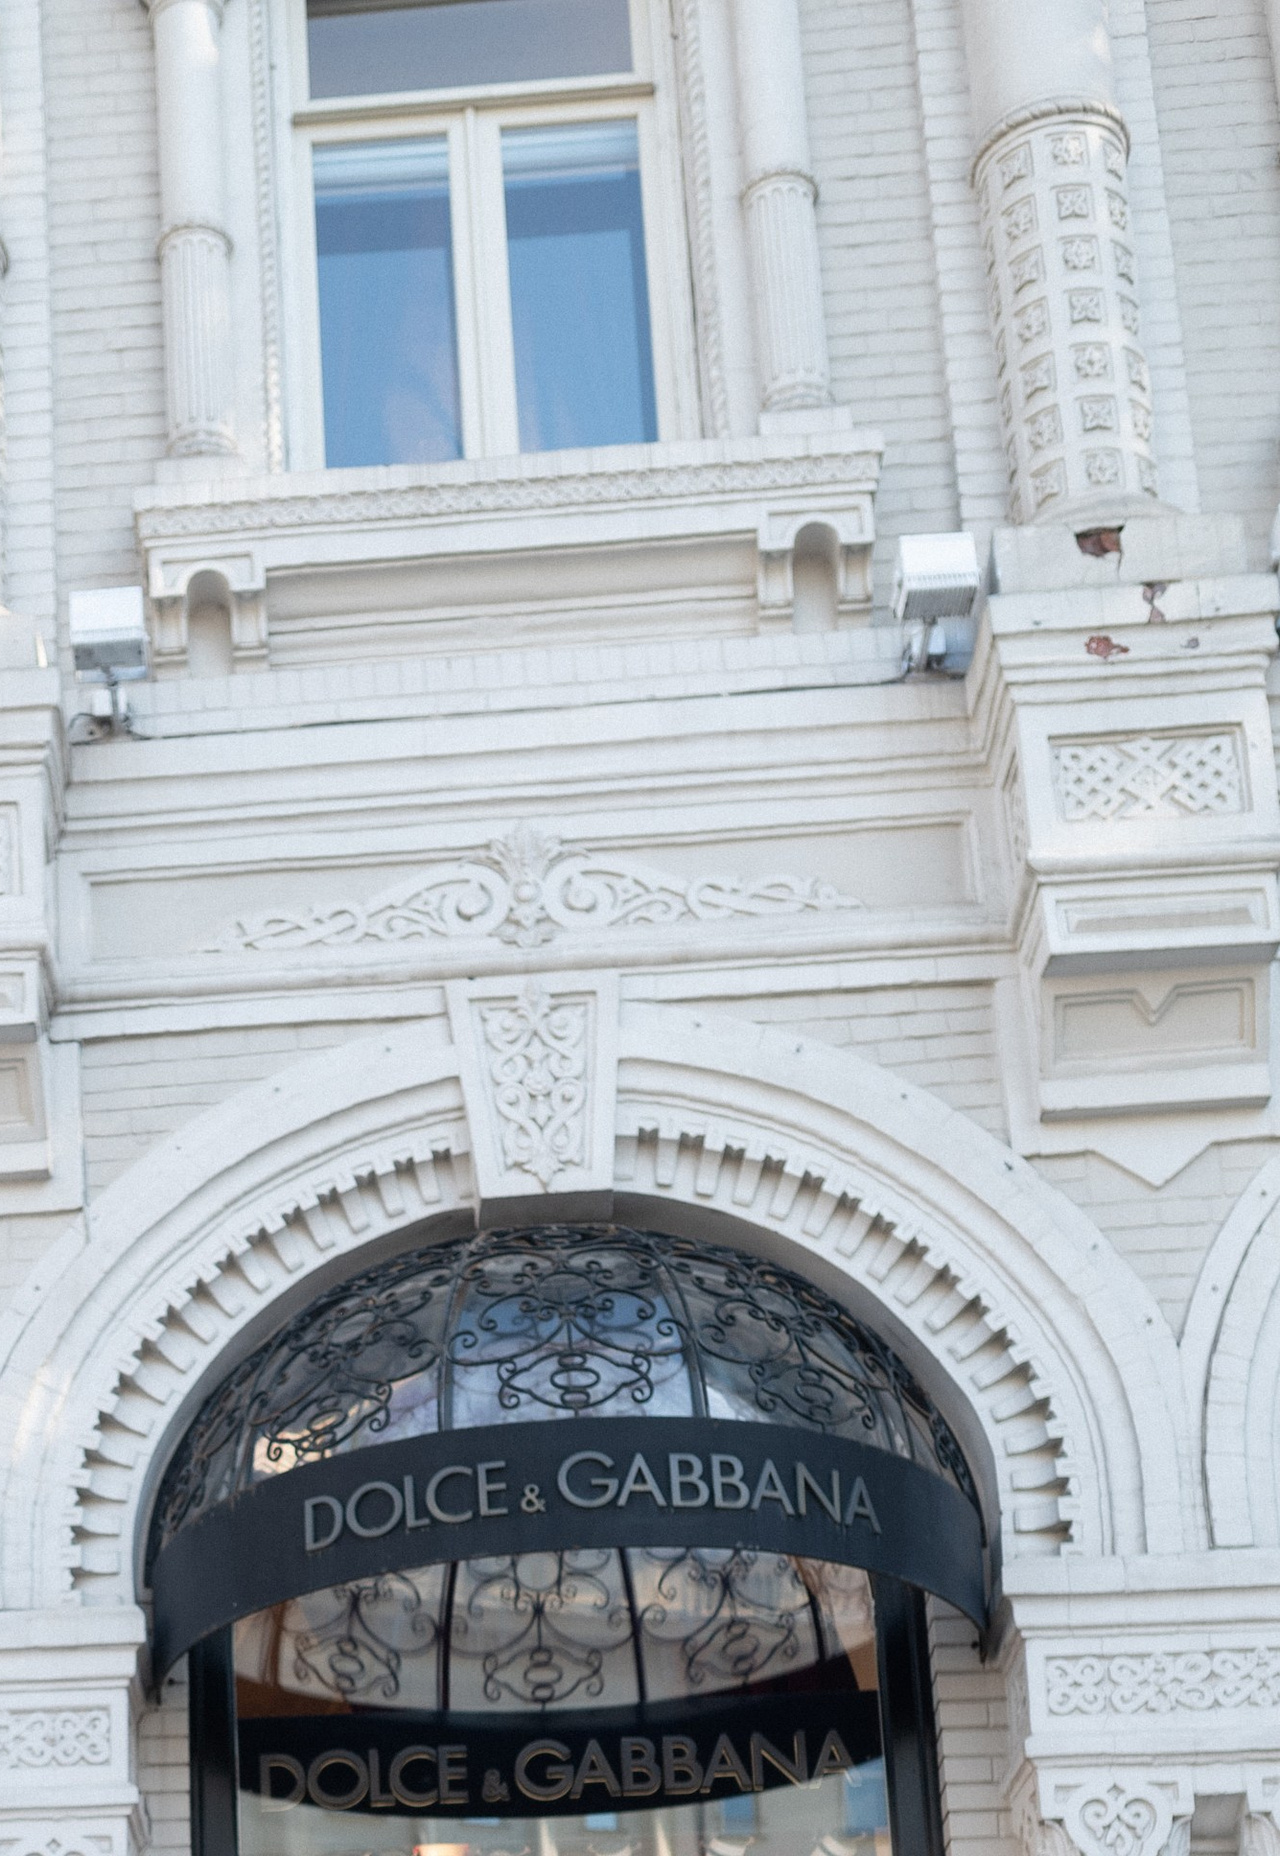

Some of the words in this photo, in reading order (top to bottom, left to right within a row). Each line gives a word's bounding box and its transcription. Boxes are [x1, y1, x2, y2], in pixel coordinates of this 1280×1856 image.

[303, 1459, 509, 1553] DOLCE
[521, 1483, 547, 1514] &
[557, 1450, 883, 1536] GABBANA
[259, 1744, 470, 1814] DOLCE
[482, 1768, 511, 1803] &
[514, 1729, 863, 1802] GABBANA
